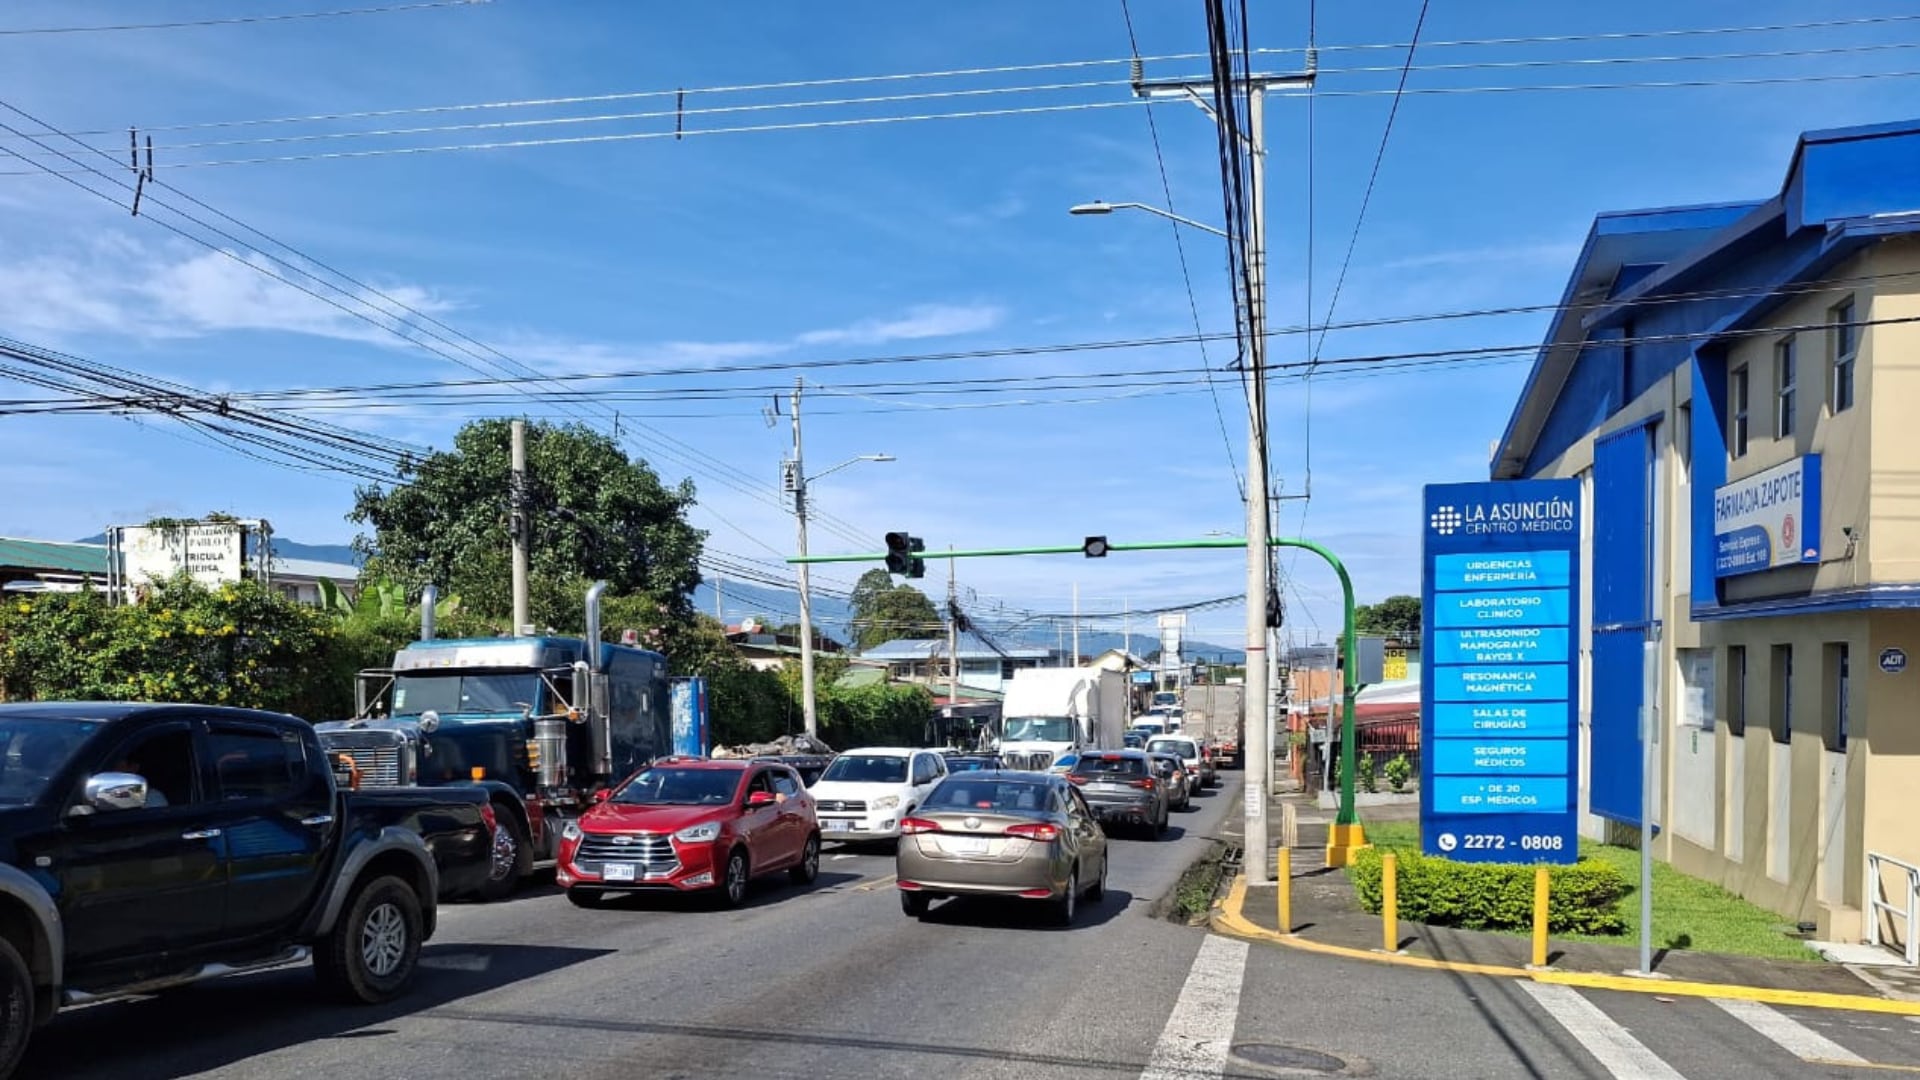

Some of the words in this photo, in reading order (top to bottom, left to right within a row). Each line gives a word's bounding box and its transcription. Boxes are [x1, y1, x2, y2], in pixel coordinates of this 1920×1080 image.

[1716, 487, 1760, 521] FARMACIA
[1762, 472, 1801, 508] ZAPOTE
[1465, 503, 1486, 522] LA
[1490, 496, 1573, 521] ASUNCIÓN
[1465, 521, 1517, 534] CENTRO
[1466, 559, 1532, 570] URGENCIAS
[1459, 596, 1542, 608] LABORATORIO
[1460, 627, 1541, 638] ULTRASONIDO
[1476, 651, 1513, 662] RAYOS
[1517, 651, 1525, 661] X
[1882, 654, 1904, 665] ADT
[1462, 671, 1537, 681] RESONANCIA
[1473, 708, 1509, 717] SALAS
[1511, 708, 1527, 717] DE
[1473, 746, 1527, 756] SEGUROS
[1488, 784, 1503, 793] DE
[1506, 784, 1521, 793] 20
[1463, 834, 1505, 849] 2272
[1520, 835, 1564, 850] 0808
